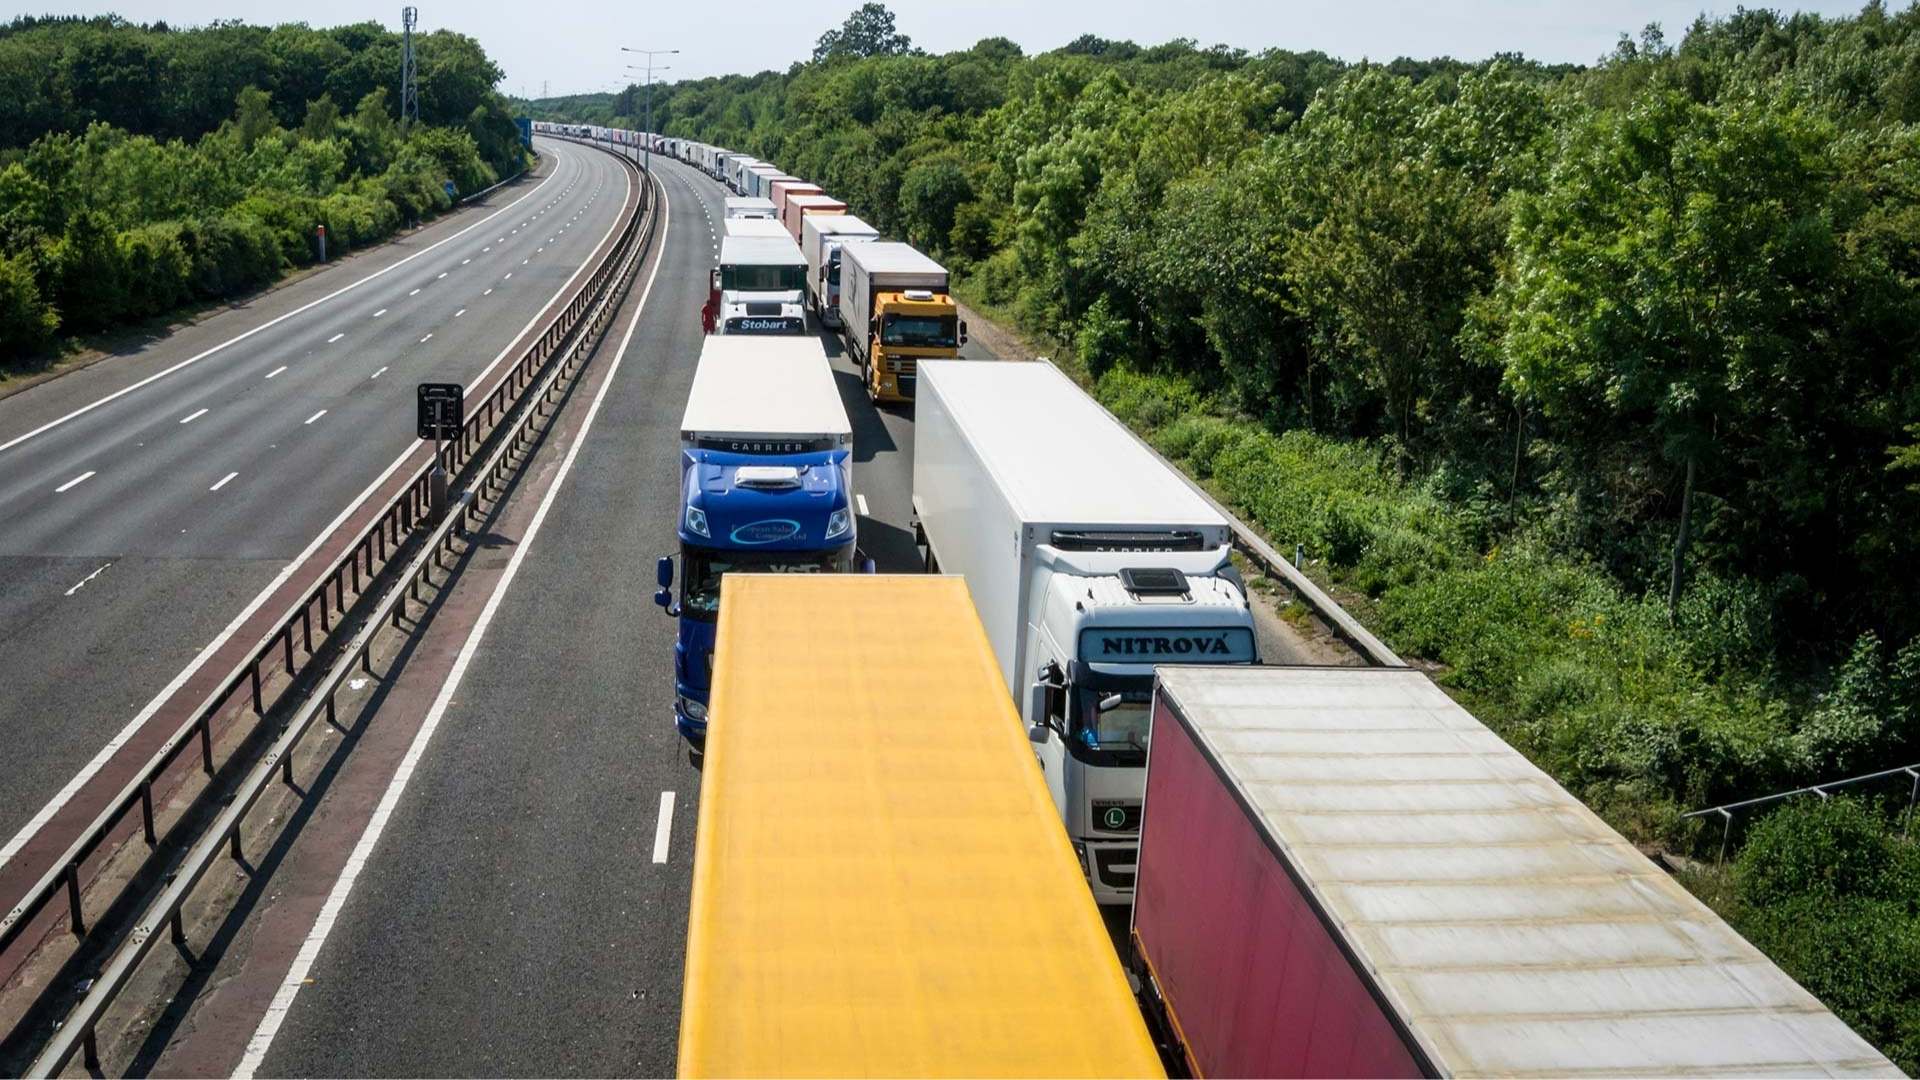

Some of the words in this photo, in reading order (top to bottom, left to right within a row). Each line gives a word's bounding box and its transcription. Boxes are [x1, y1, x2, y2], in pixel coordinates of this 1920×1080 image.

[741, 320, 787, 329] Stobart
[731, 443, 802, 451] CARRIER
[1102, 632, 1231, 655] NITROVÁ
[1110, 811, 1119, 824] L
